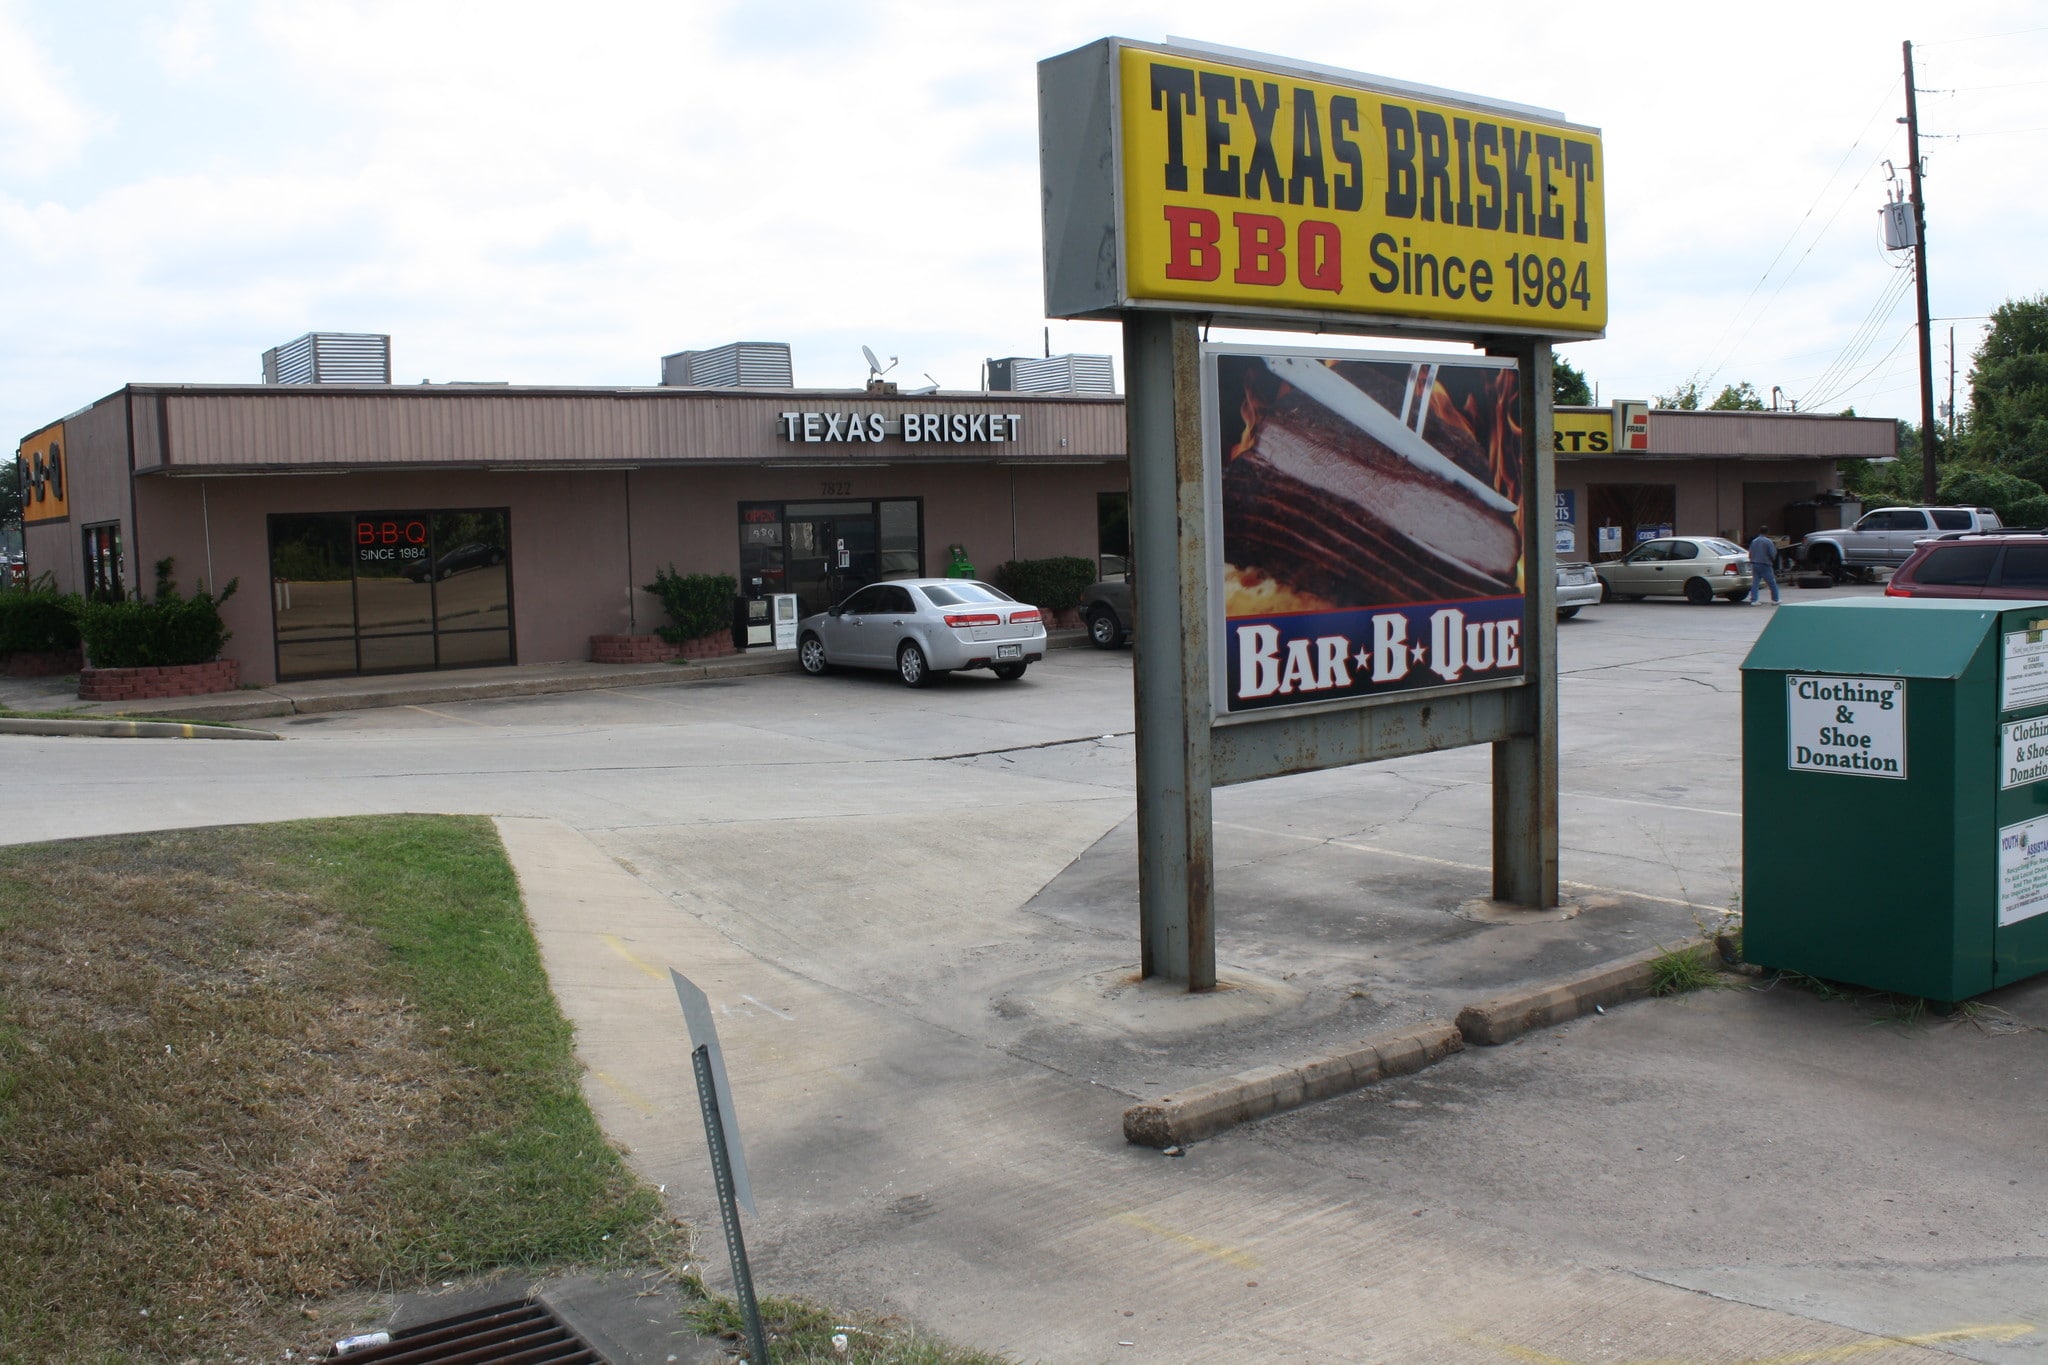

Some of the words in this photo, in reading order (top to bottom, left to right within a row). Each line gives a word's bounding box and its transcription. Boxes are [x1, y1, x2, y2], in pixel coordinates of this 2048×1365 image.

[1150, 63, 1363, 212] TEXAS
[1381, 103, 1594, 244] BRISKET
[1164, 204, 1344, 295] BBQ
[1369, 232, 1493, 302] Since
[1505, 252, 1591, 311] 1984
[782, 412, 885, 442] TEXAS
[903, 413, 1021, 443] BRISKET
[821, 482, 851, 495] 7822
[745, 510, 776, 522] OPEN
[360, 548, 395, 560] SINCE
[399, 547, 425, 558] 1984
[1798, 680, 1894, 710] Clothing
[1836, 705, 1854, 724] &
[1820, 727, 1871, 748] Shoe
[1796, 746, 1898, 772] Donation
[2016, 747, 2025, 762] &
[2002, 834, 2018, 851] YOUTH
